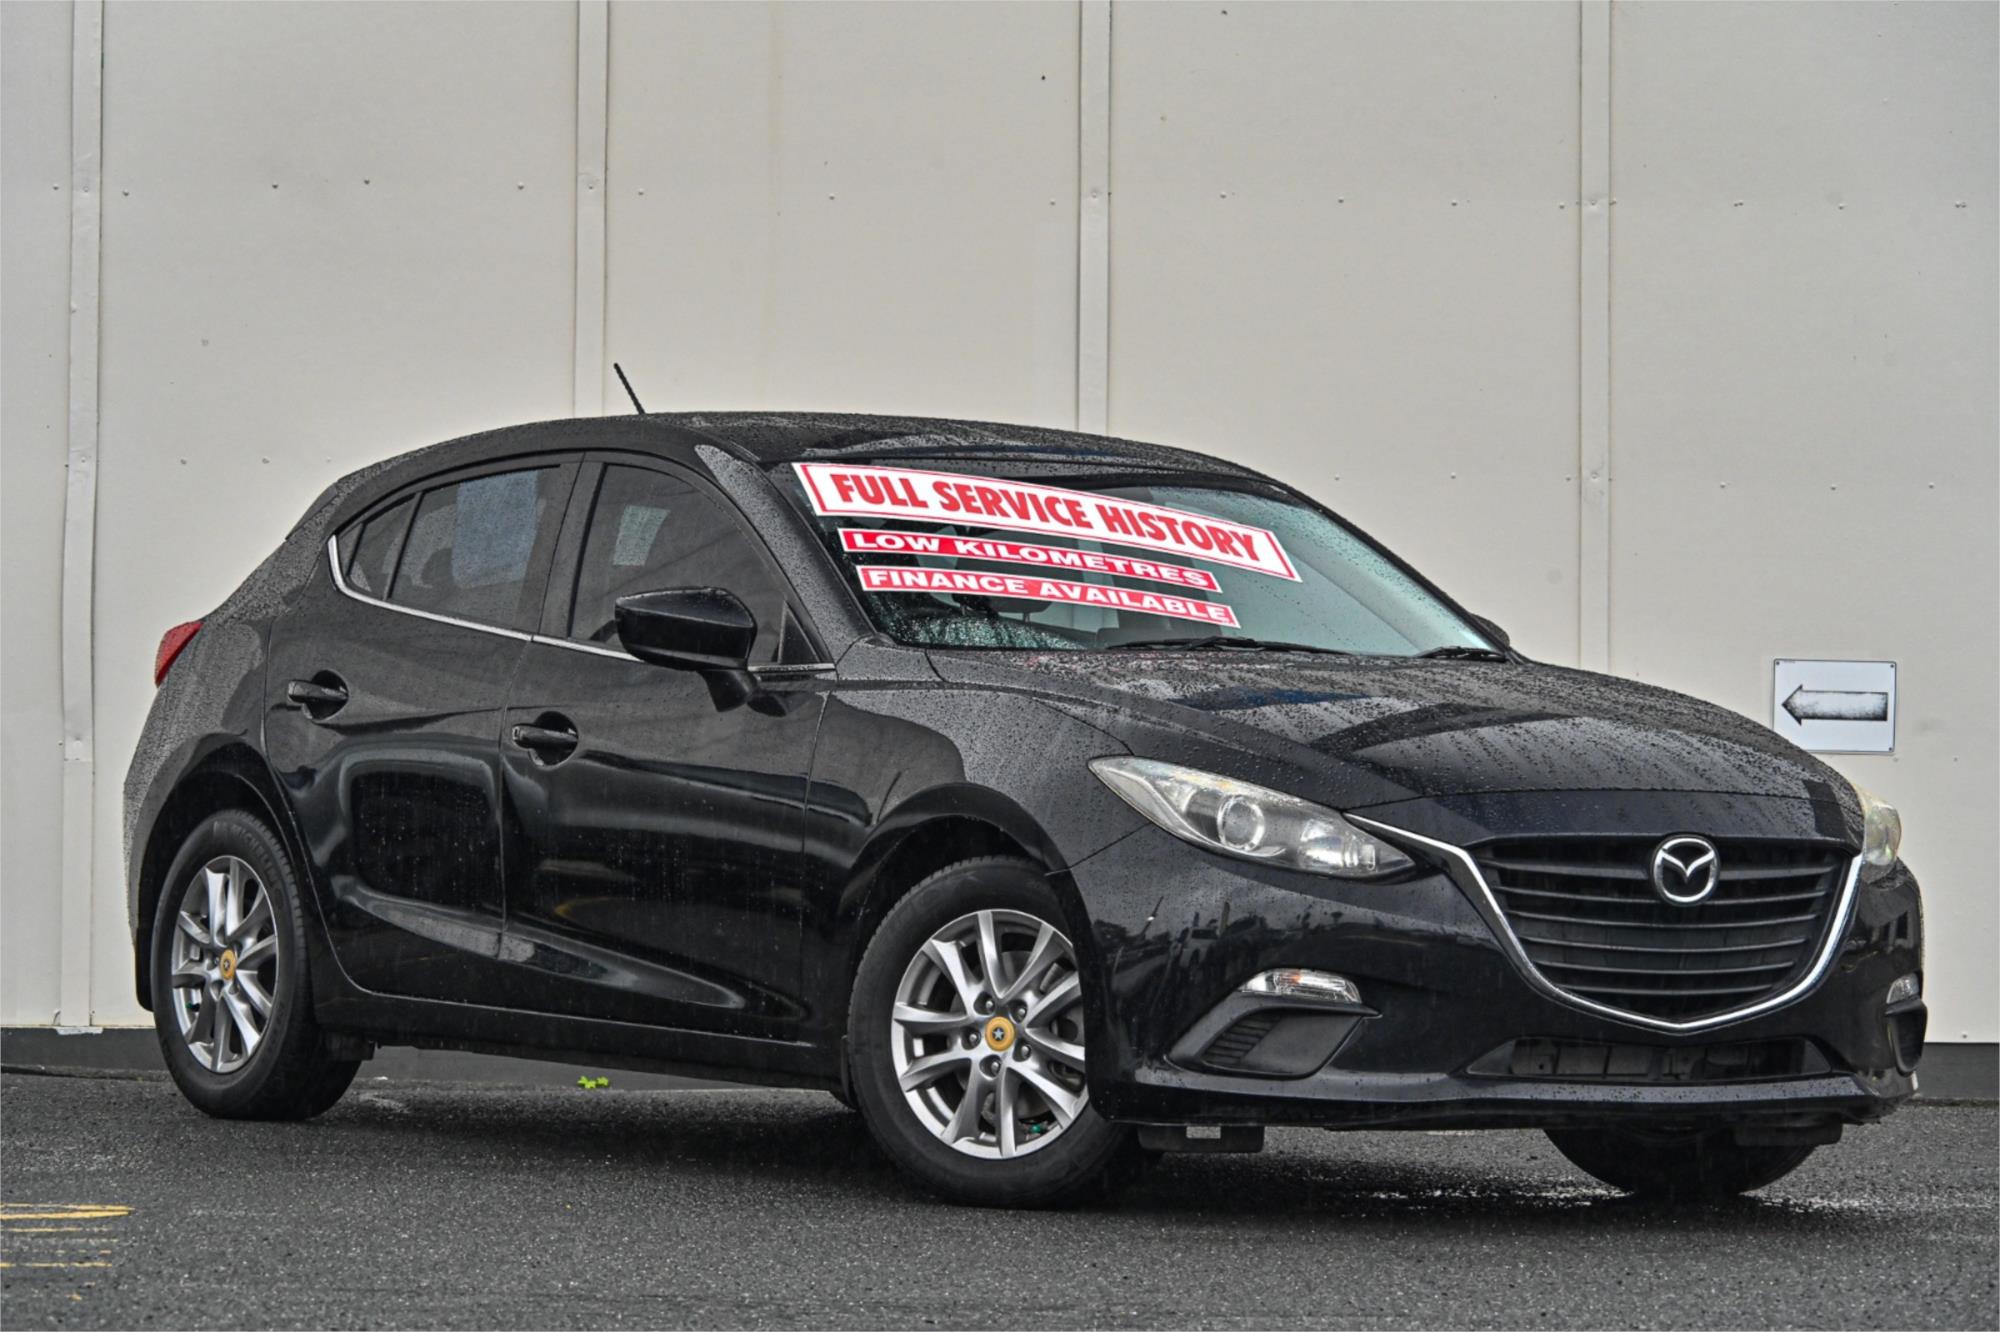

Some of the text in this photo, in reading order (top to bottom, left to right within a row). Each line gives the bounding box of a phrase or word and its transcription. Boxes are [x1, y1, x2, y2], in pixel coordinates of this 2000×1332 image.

[829, 473, 1261, 562] FULL SERVICE HISTORY
[852, 533, 1210, 587] LOW KILOMETRES
[867, 570, 1231, 624] FINANCE AVAILABLE
